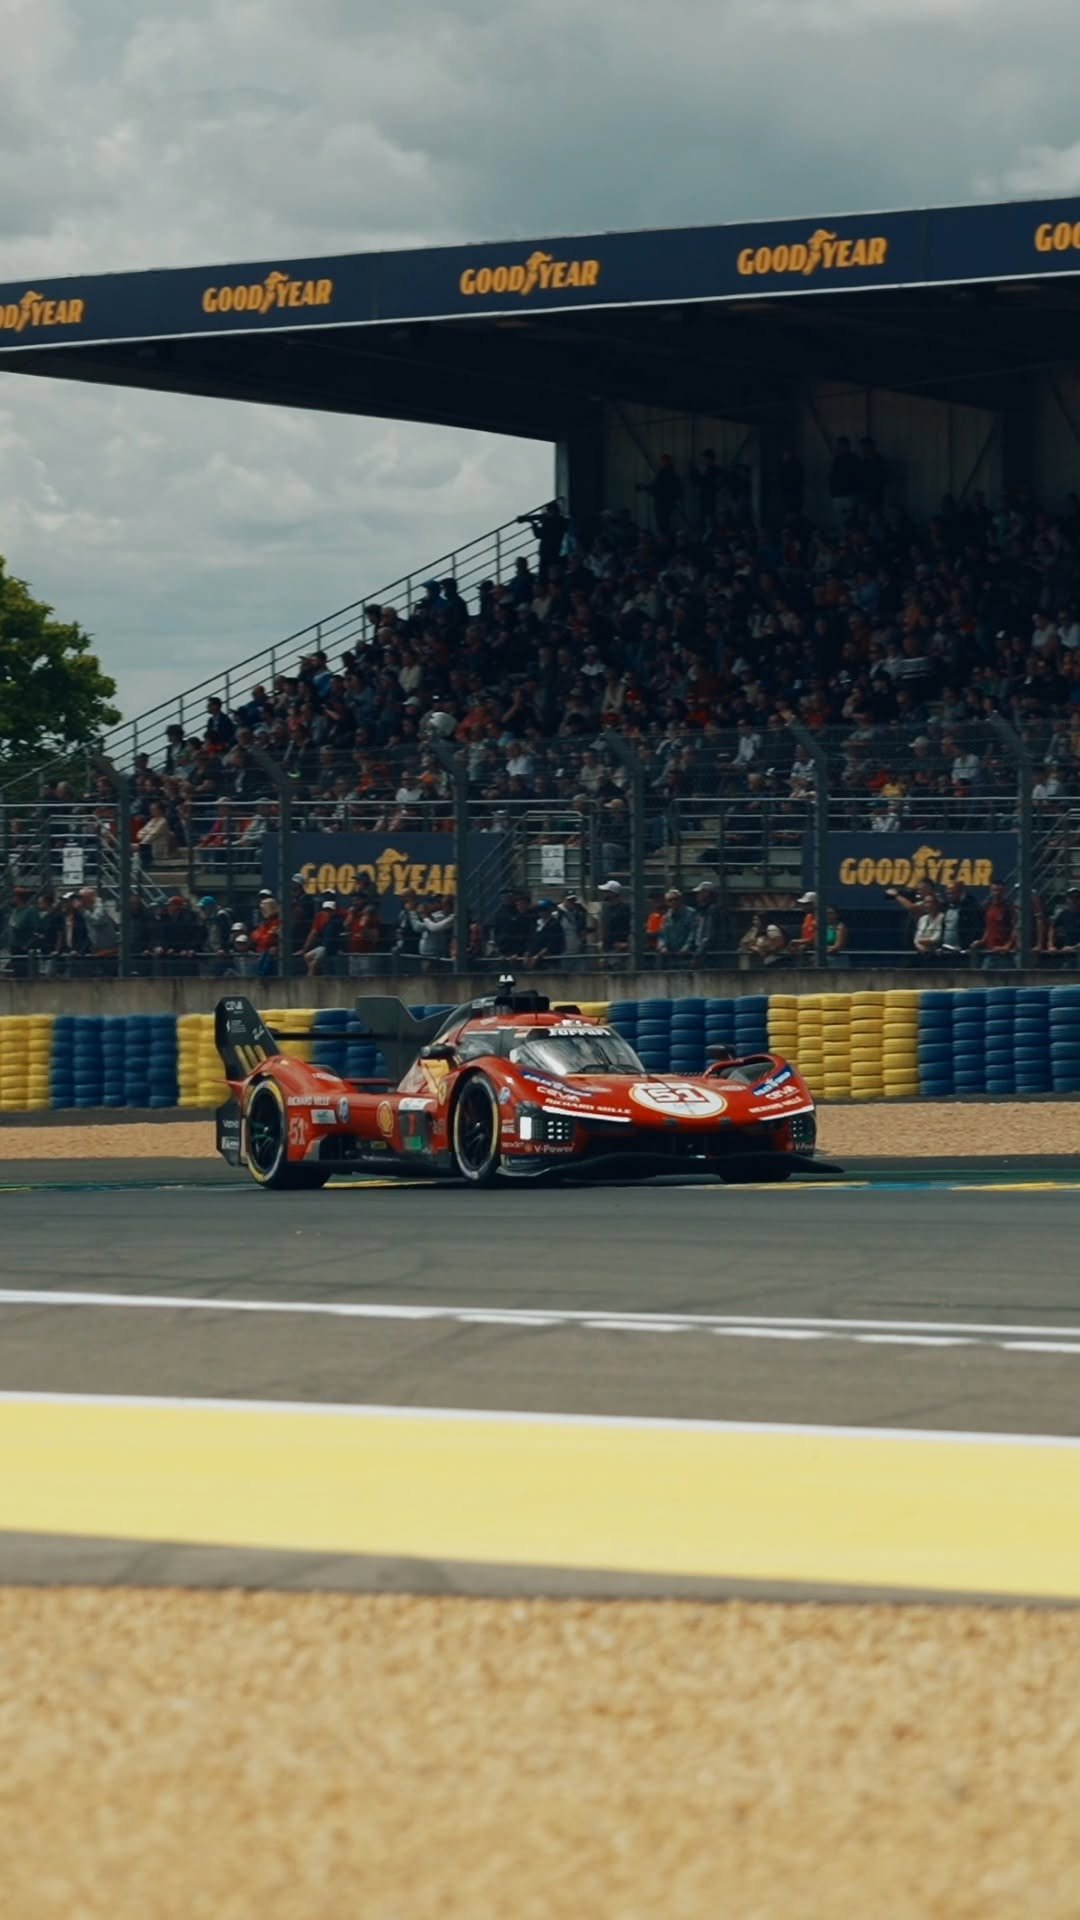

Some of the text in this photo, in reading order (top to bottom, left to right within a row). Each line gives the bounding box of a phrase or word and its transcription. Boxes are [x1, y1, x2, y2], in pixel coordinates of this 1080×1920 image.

[737, 231, 887, 275] GOODYEAR
[202, 273, 333, 314] GOODYEAR
[460, 253, 599, 295] GOODYEAR
[839, 846, 993, 888] GOODYEAR
[642, 1088, 710, 1103] 51
[288, 1117, 306, 1146] 51
[534, 1143, 575, 1153] V-Power
